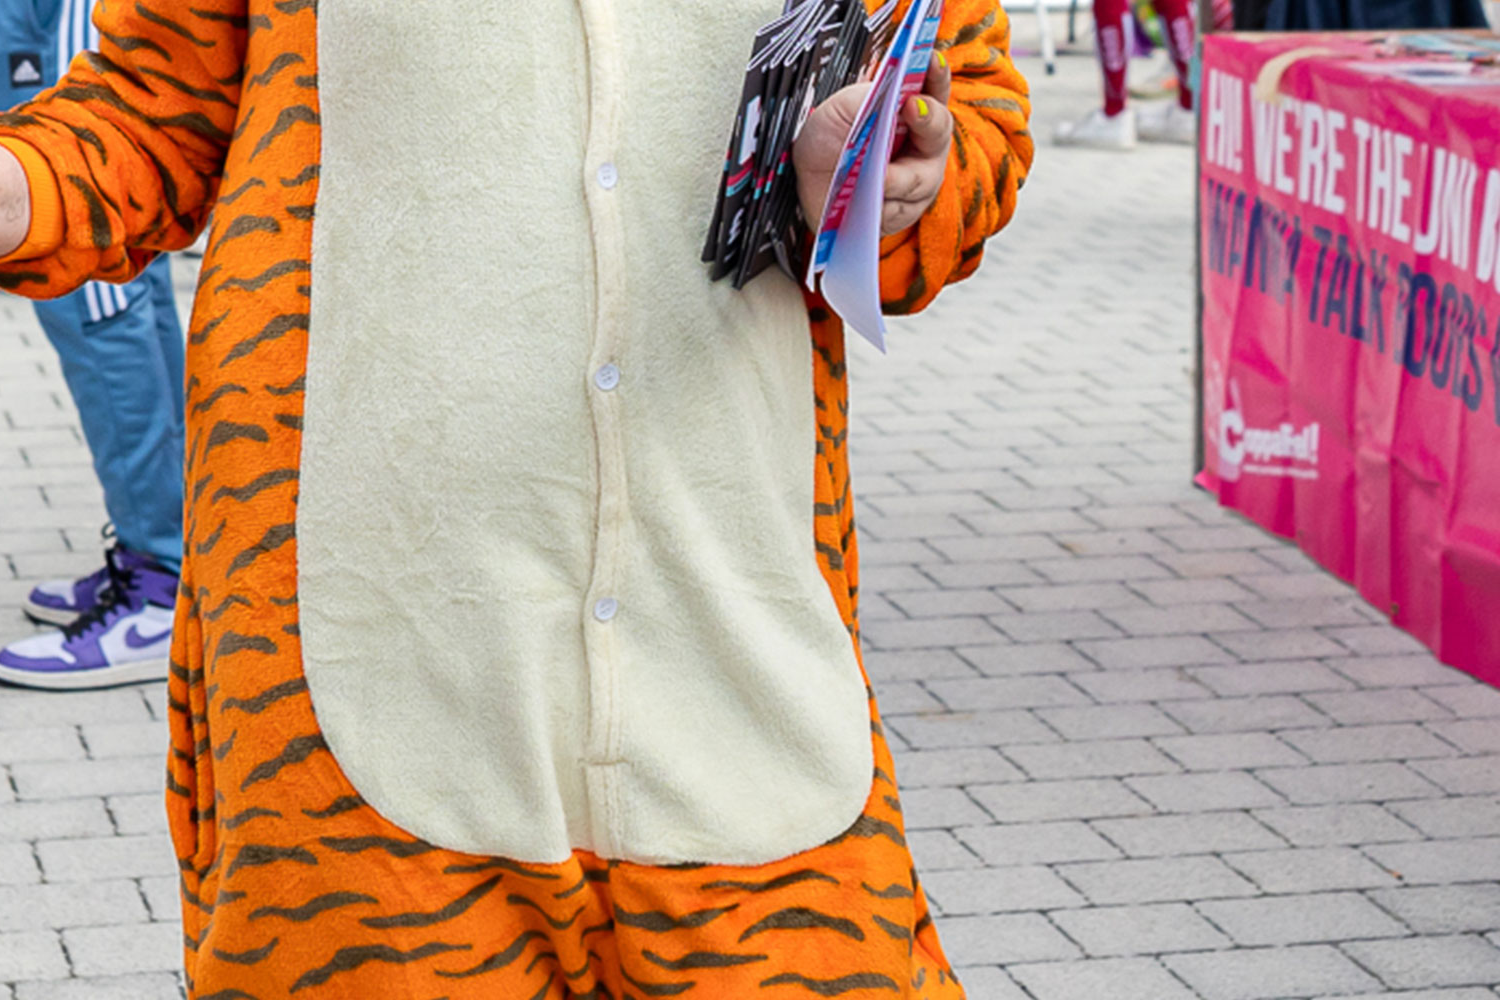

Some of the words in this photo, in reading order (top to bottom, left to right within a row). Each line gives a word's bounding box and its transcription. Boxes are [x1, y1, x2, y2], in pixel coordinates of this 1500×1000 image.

[1206, 68, 1244, 174] HI!
[1353, 117, 1414, 244] THE
[1309, 224, 1389, 354] TALK
